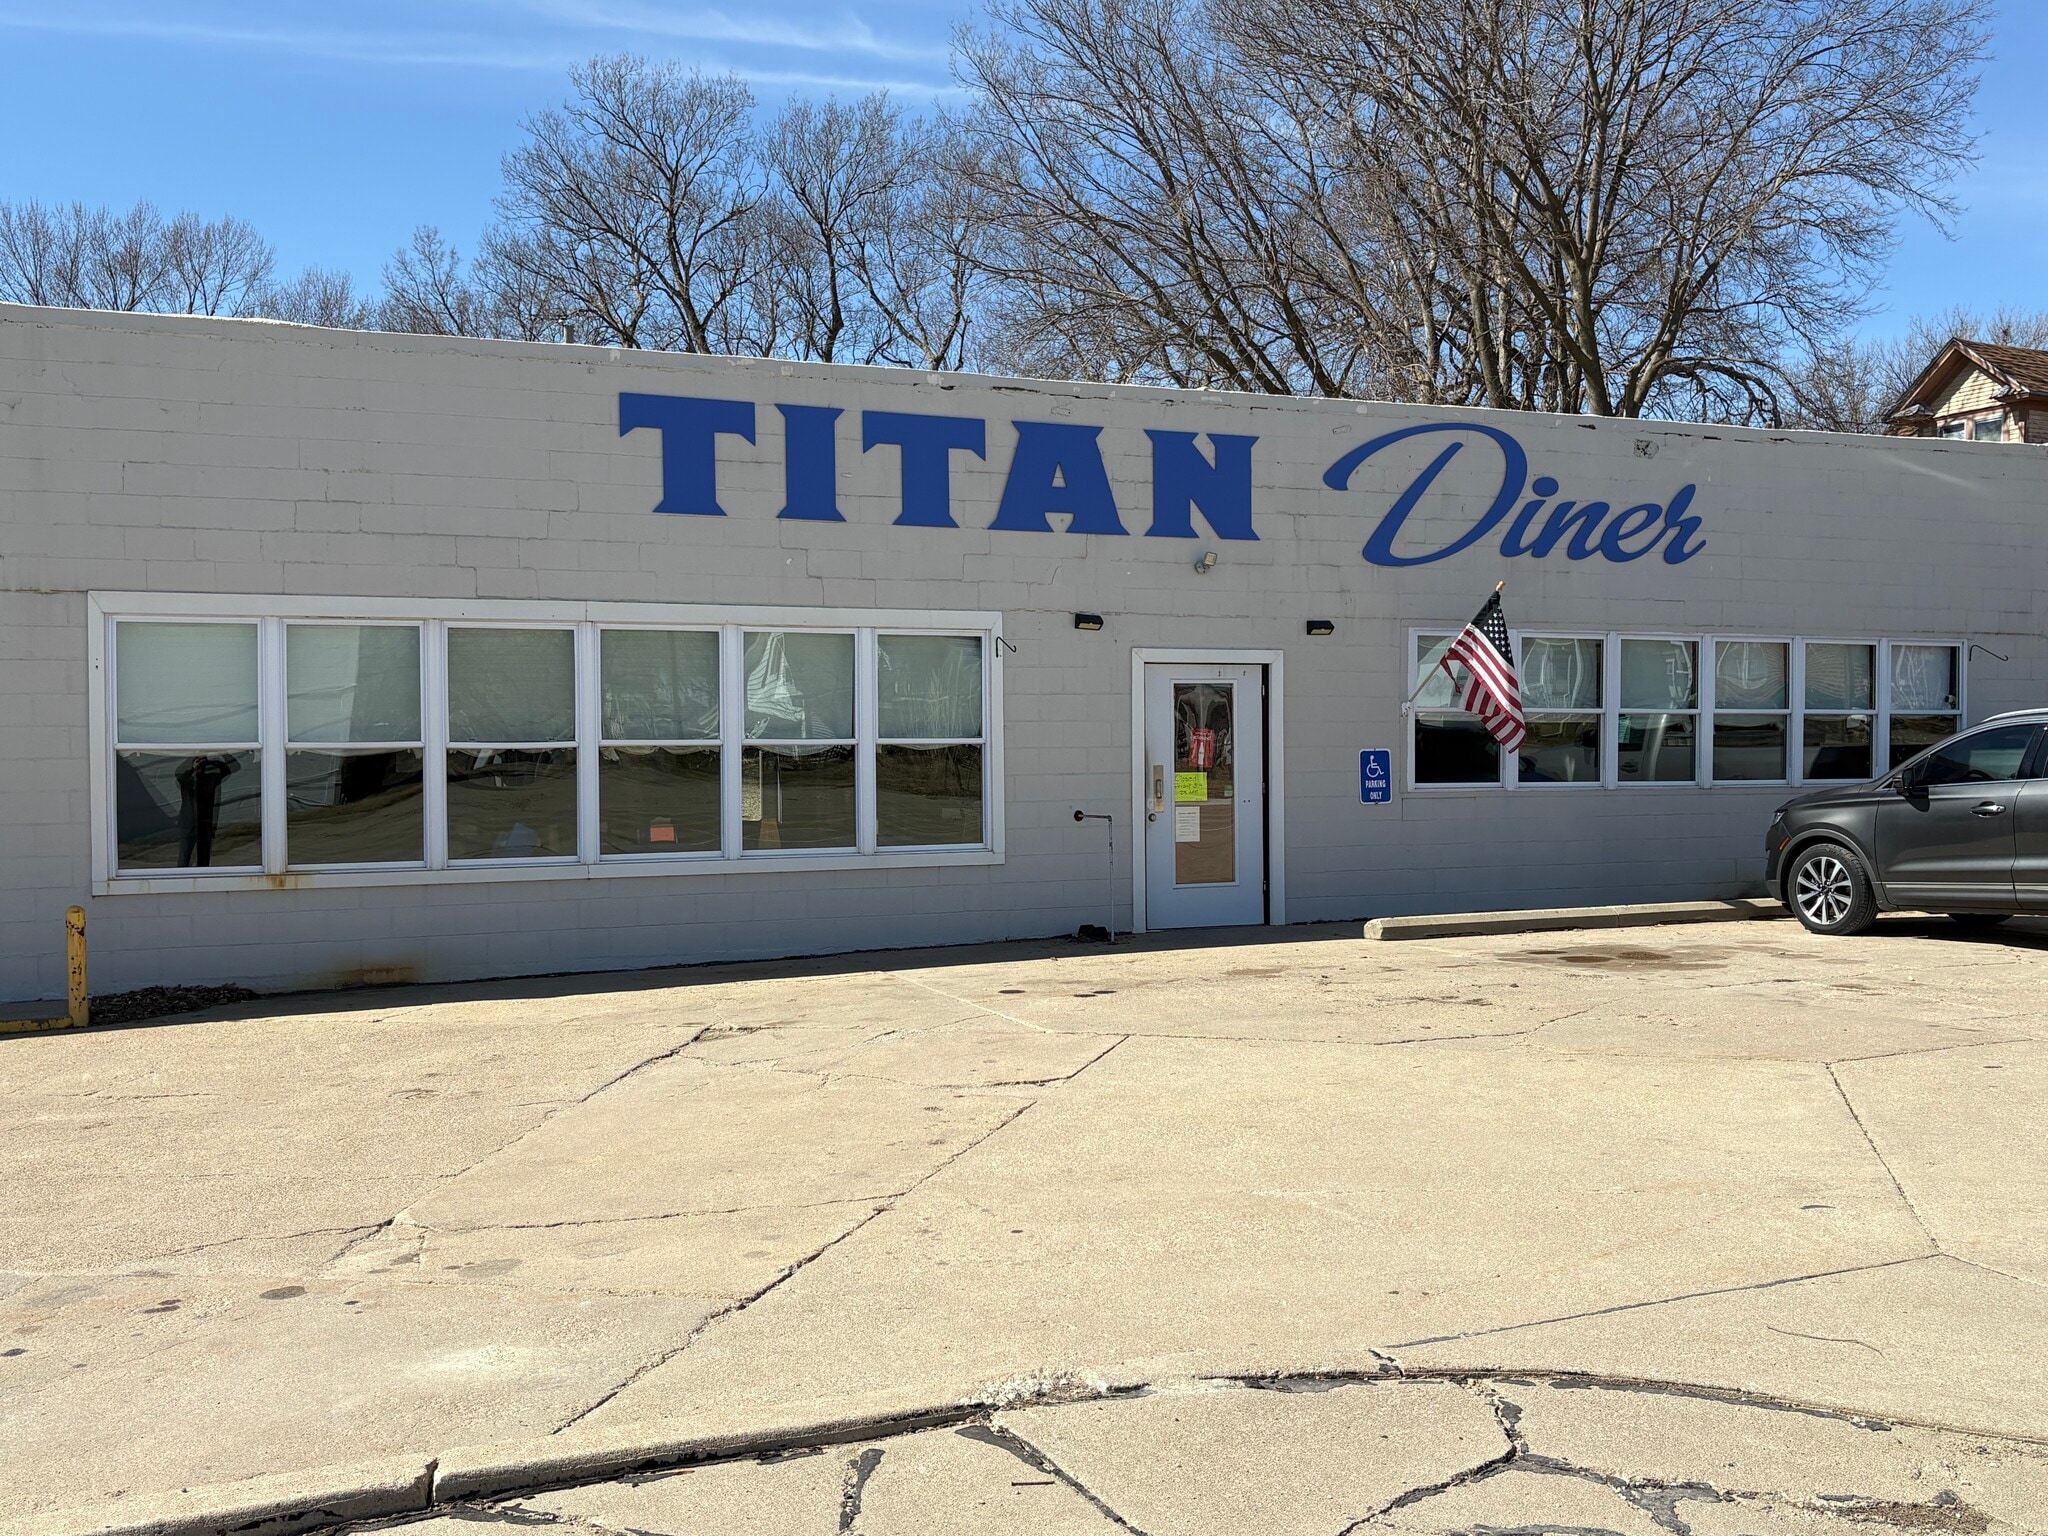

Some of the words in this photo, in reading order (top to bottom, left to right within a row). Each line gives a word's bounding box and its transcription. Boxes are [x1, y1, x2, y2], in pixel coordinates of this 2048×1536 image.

[619, 392, 1261, 541] TITAN
[1323, 422, 1707, 567] Diner
[1365, 780, 1386, 789] PARKING
[1370, 791, 1382, 800] ONLY
